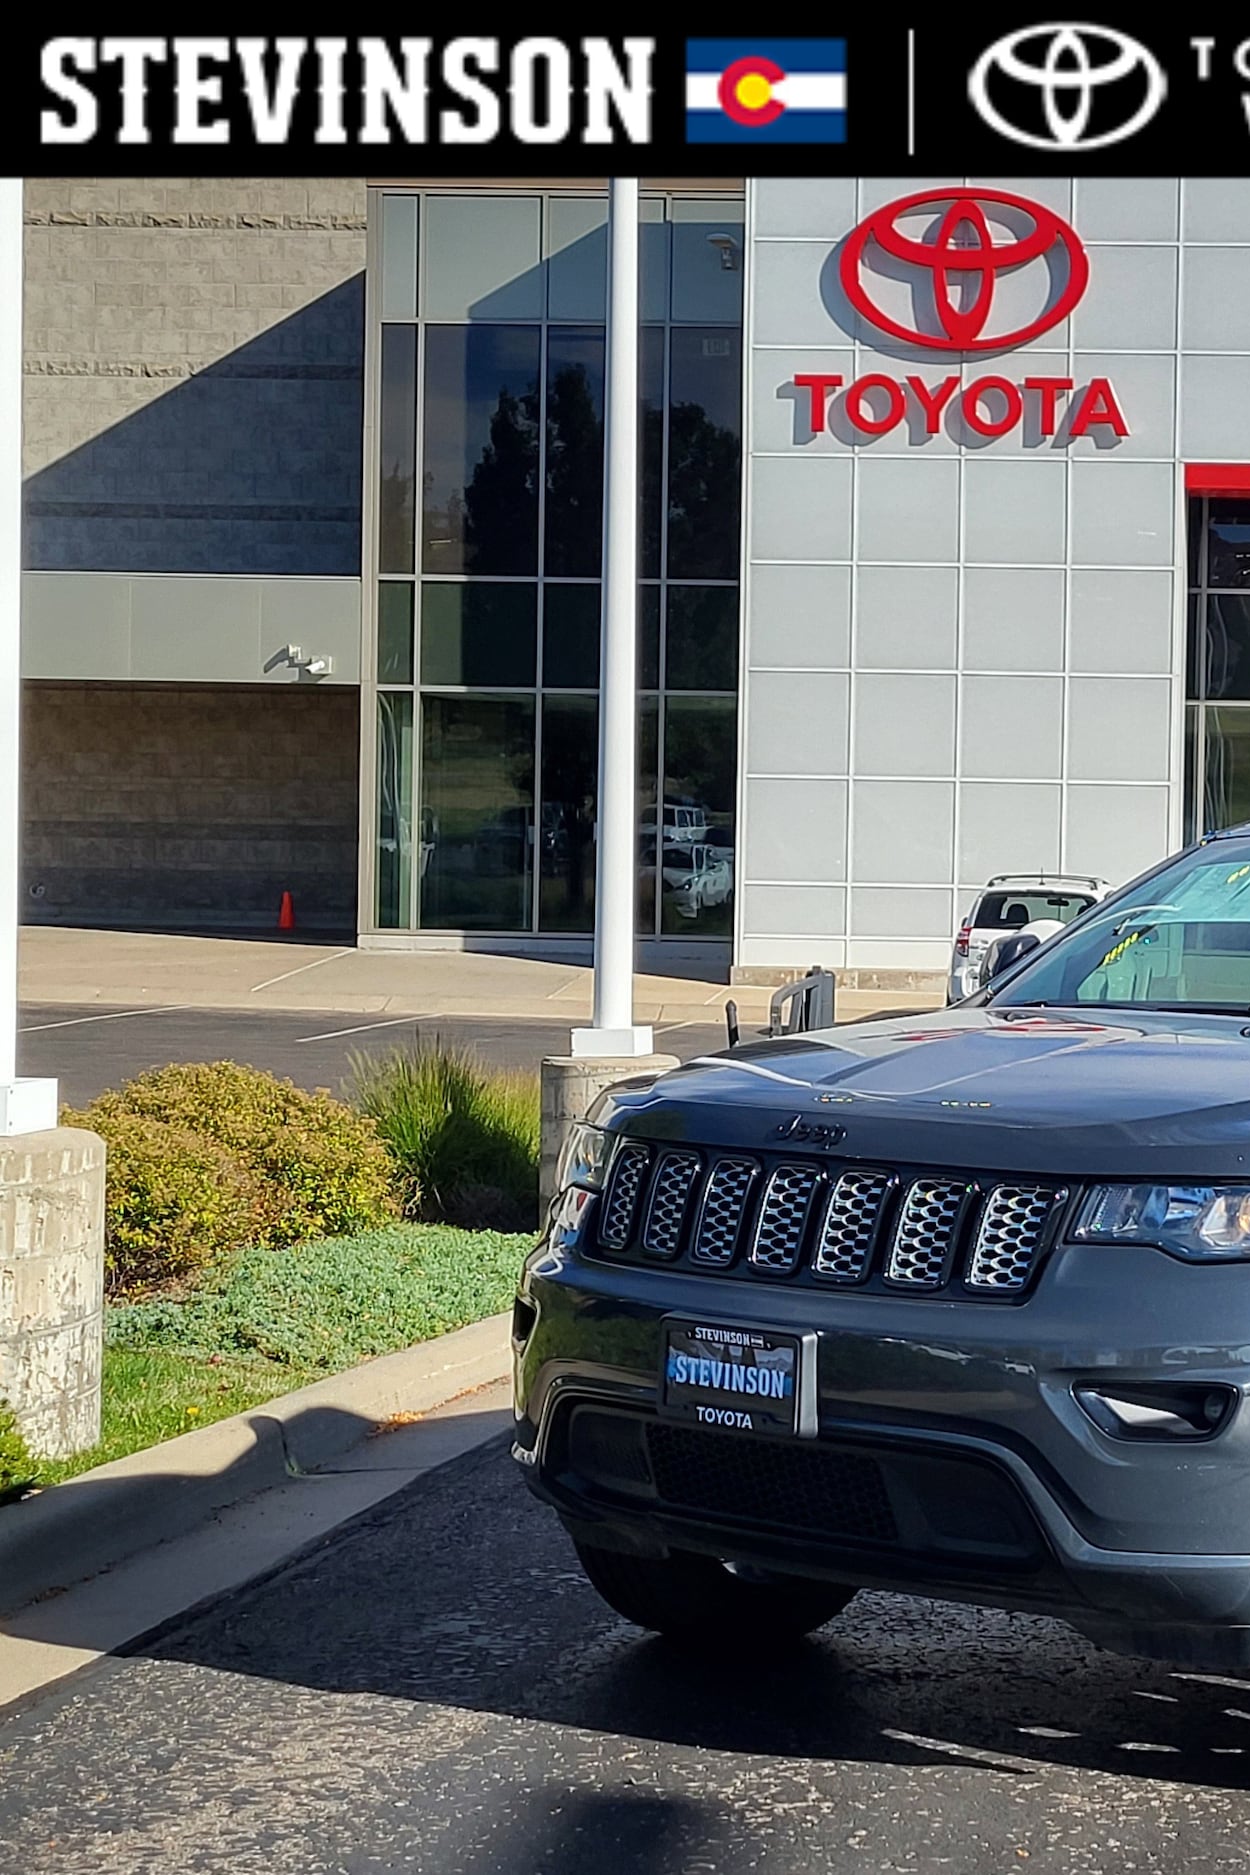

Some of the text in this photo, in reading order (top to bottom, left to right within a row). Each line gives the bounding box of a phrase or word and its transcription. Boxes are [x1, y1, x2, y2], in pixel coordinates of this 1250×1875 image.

[793, 373, 1131, 437] TOYOTA
[774, 1113, 849, 1151] Jeep
[694, 1326, 751, 1347] STEVINSON
[675, 1355, 786, 1400] STEVINSON
[695, 1406, 754, 1431] TOYOTA
